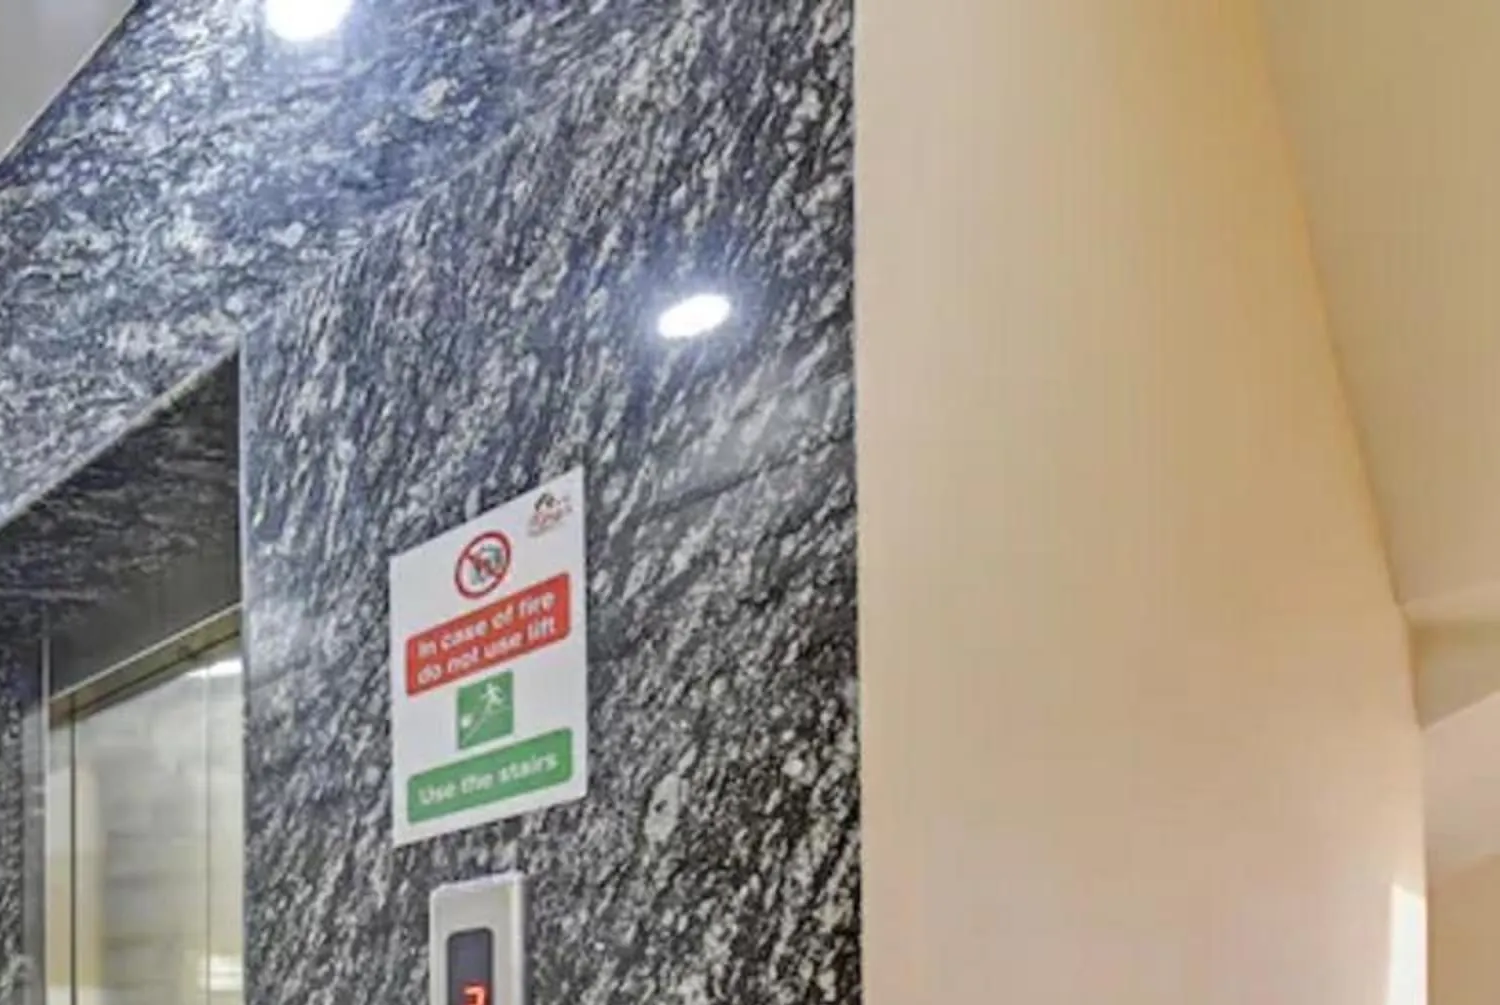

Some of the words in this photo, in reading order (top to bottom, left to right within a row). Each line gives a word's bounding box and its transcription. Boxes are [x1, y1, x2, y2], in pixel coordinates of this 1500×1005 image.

[417, 639, 437, 658] In
[440, 620, 488, 650] case
[491, 603, 514, 629] of
[518, 591, 556, 619] fire
[417, 663, 442, 685] do
[447, 646, 479, 673] not
[484, 632, 524, 659] use
[527, 615, 556, 641] lift
[418, 781, 456, 805] Use
[460, 772, 494, 794] the
[498, 752, 558, 782] stairs
